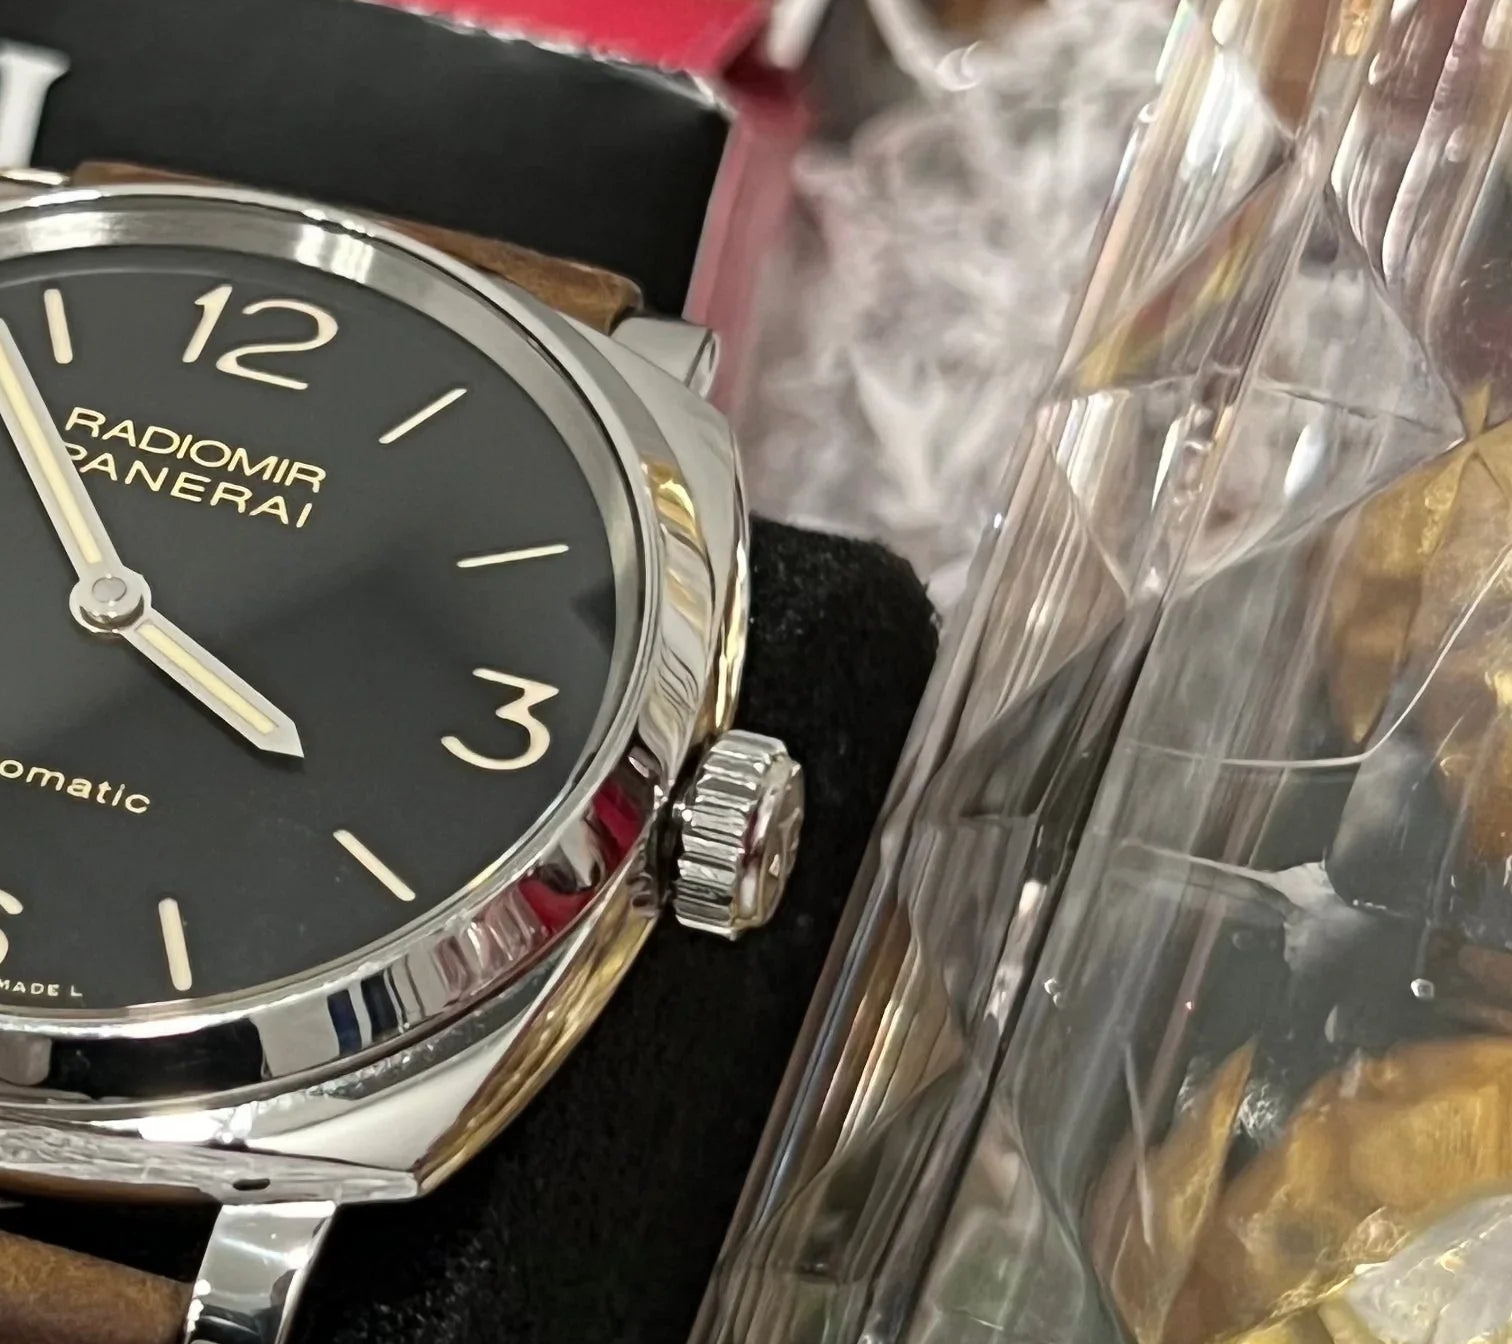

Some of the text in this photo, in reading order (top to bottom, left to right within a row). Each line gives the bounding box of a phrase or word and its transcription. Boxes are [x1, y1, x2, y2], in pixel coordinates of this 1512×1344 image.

[181, 283, 339, 390] 12
[65, 406, 327, 494] RADIOMIR
[440, 667, 560, 771] 3
